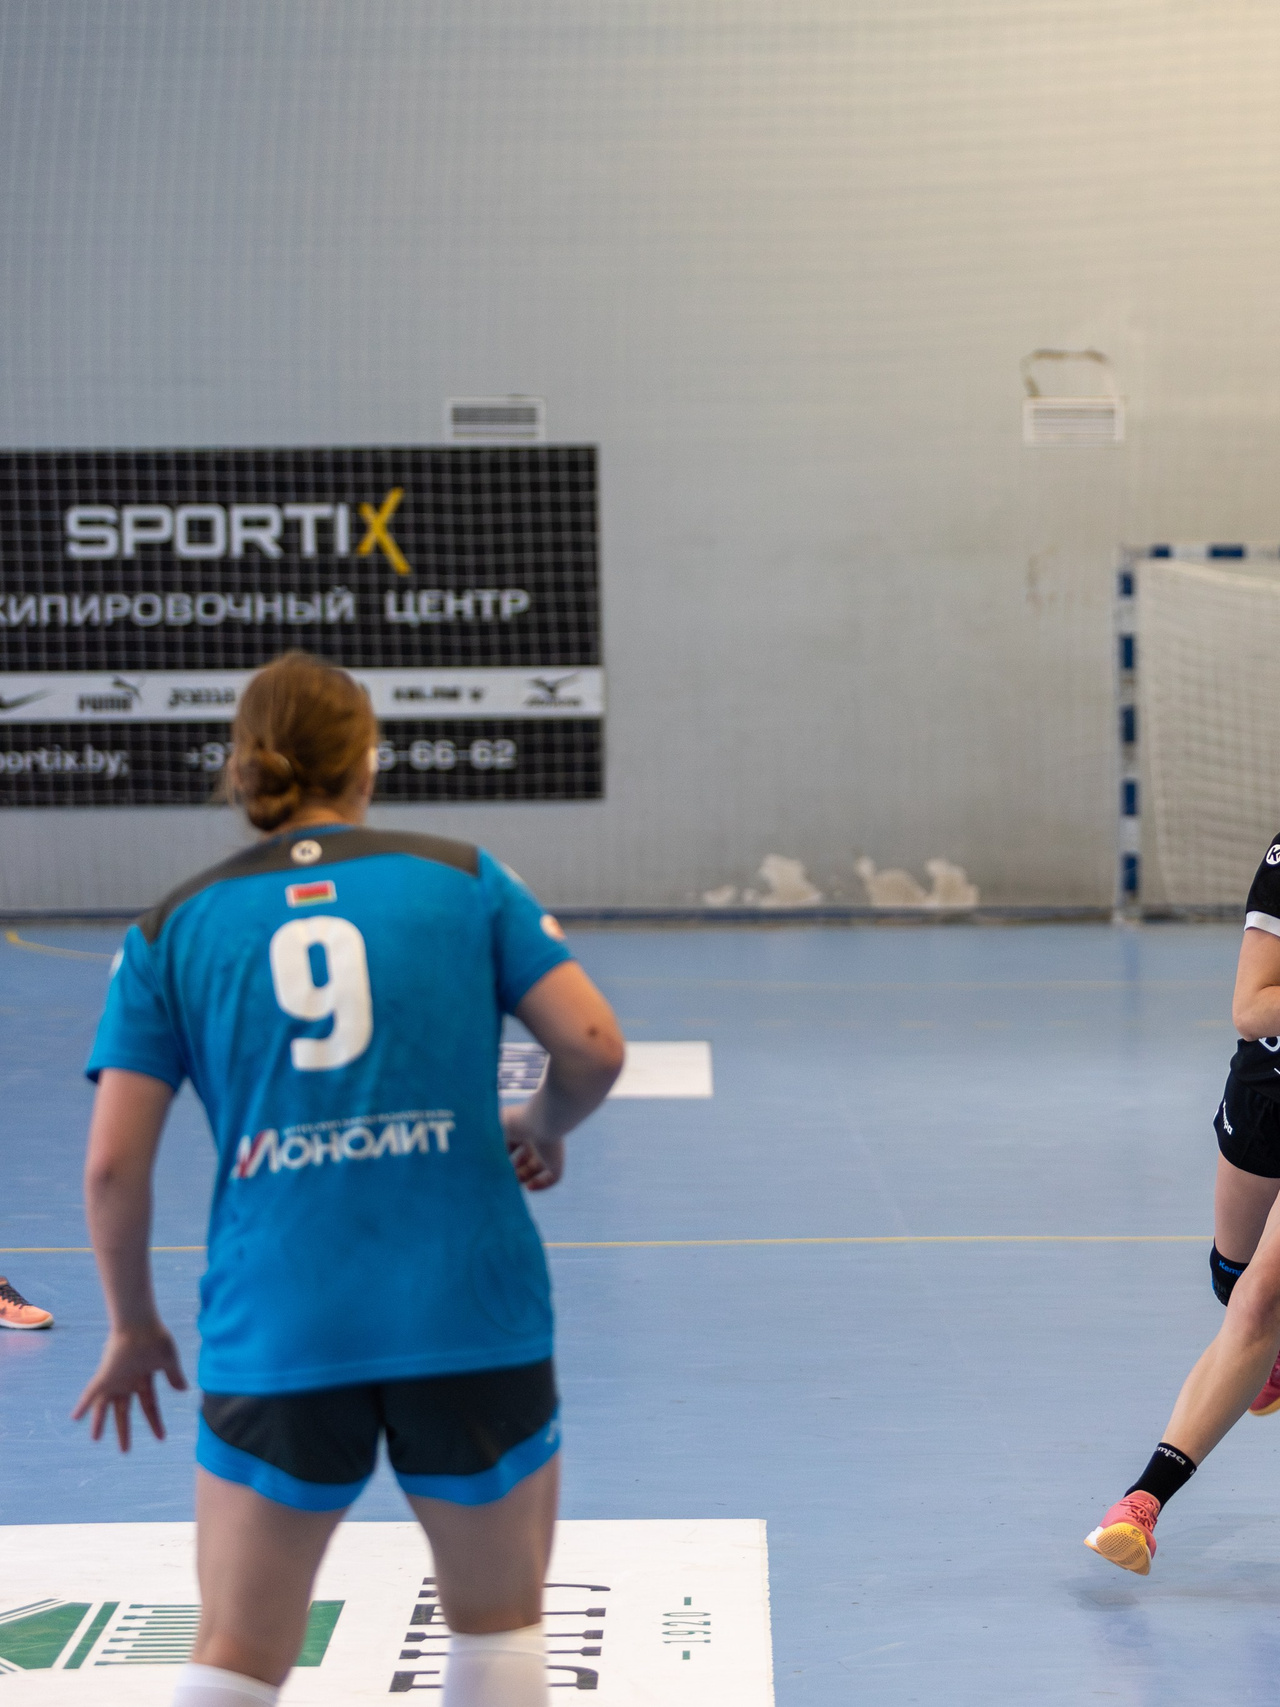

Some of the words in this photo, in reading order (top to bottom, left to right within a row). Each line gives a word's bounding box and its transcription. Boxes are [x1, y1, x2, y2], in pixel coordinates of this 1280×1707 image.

[66, 486, 412, 575] SPORTIX
[0, 586, 356, 627] ИПИРОВОЧНЫЙ
[386, 588, 531, 628] ЦЕНТР
[0, 744, 129, 778] ortix.by;
[270, 915, 374, 1071] 9
